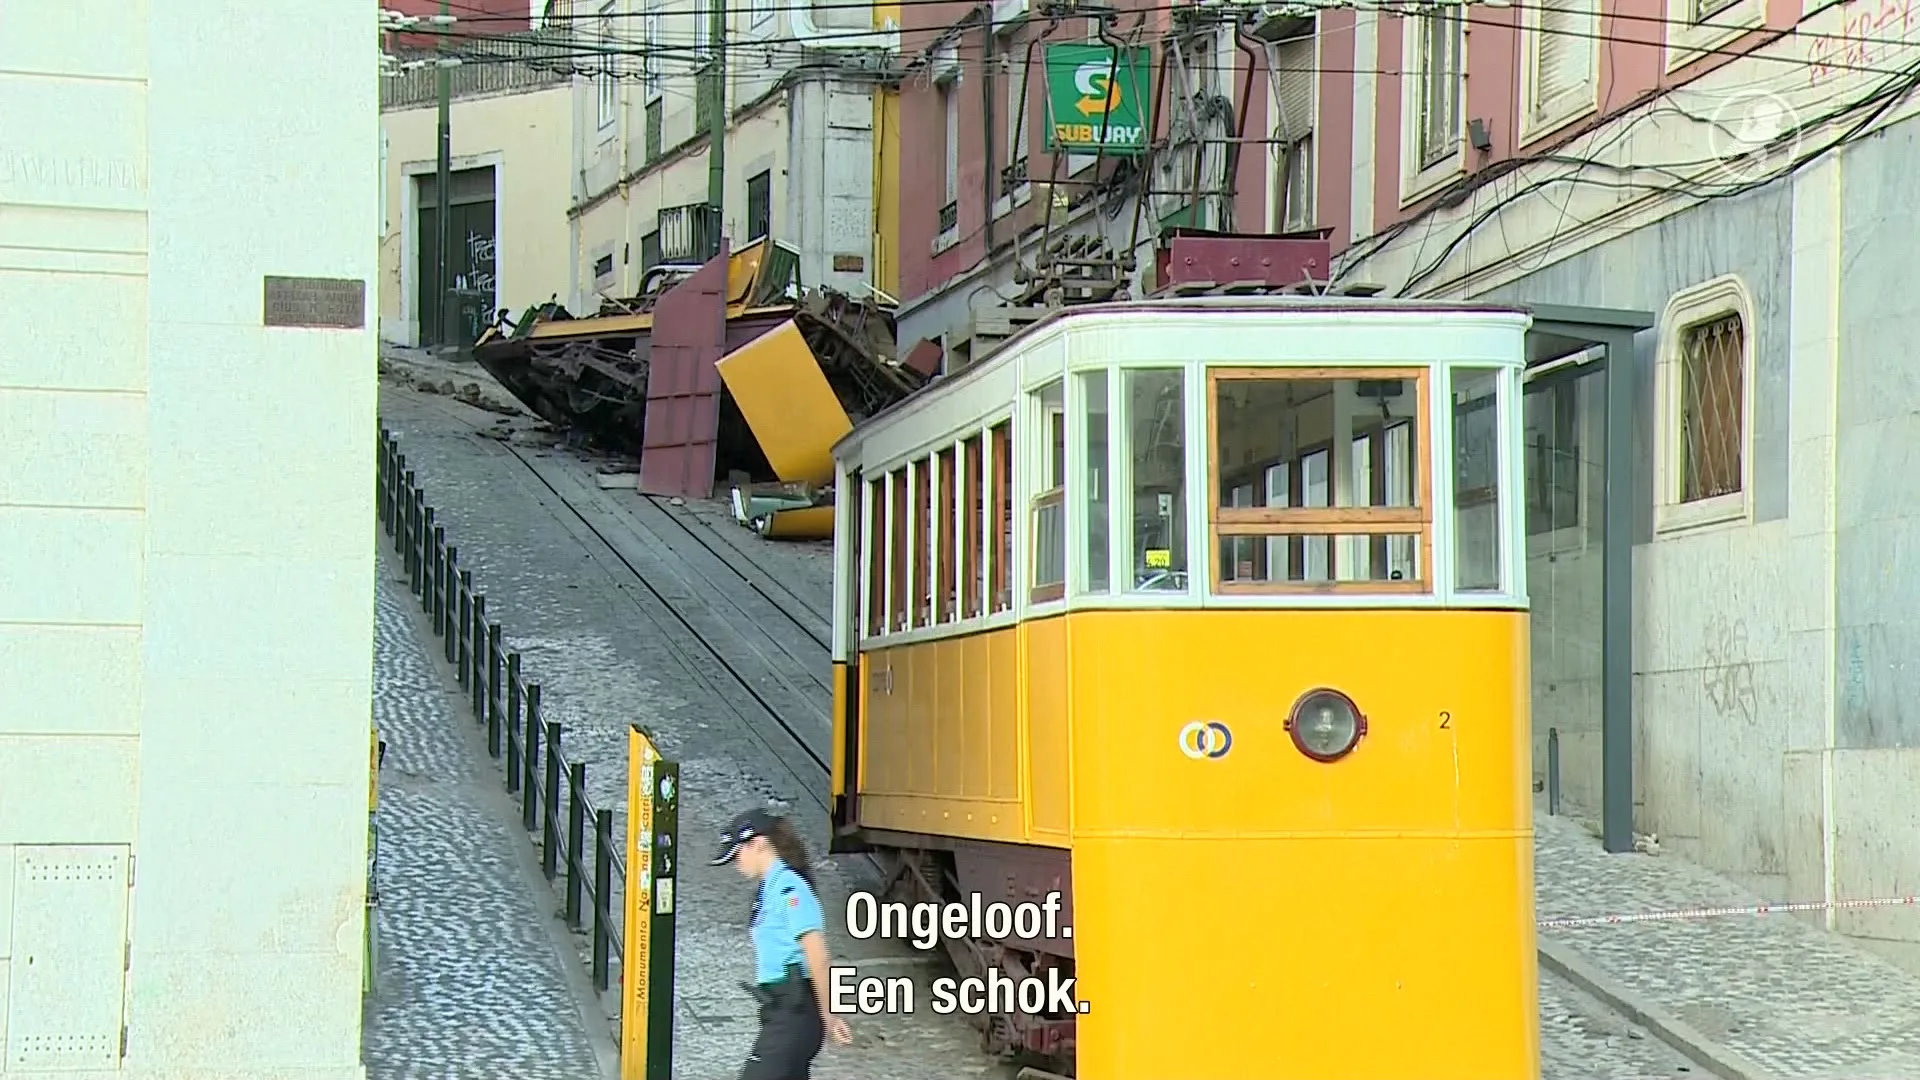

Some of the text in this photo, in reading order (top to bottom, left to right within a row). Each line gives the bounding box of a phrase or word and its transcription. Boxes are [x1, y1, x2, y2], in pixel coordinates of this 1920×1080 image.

[1053, 123, 1143, 143] SUBWAY
[1439, 710, 1451, 729] 2
[638, 849, 650, 912] Nanal
[636, 920, 647, 1000] Monumento
